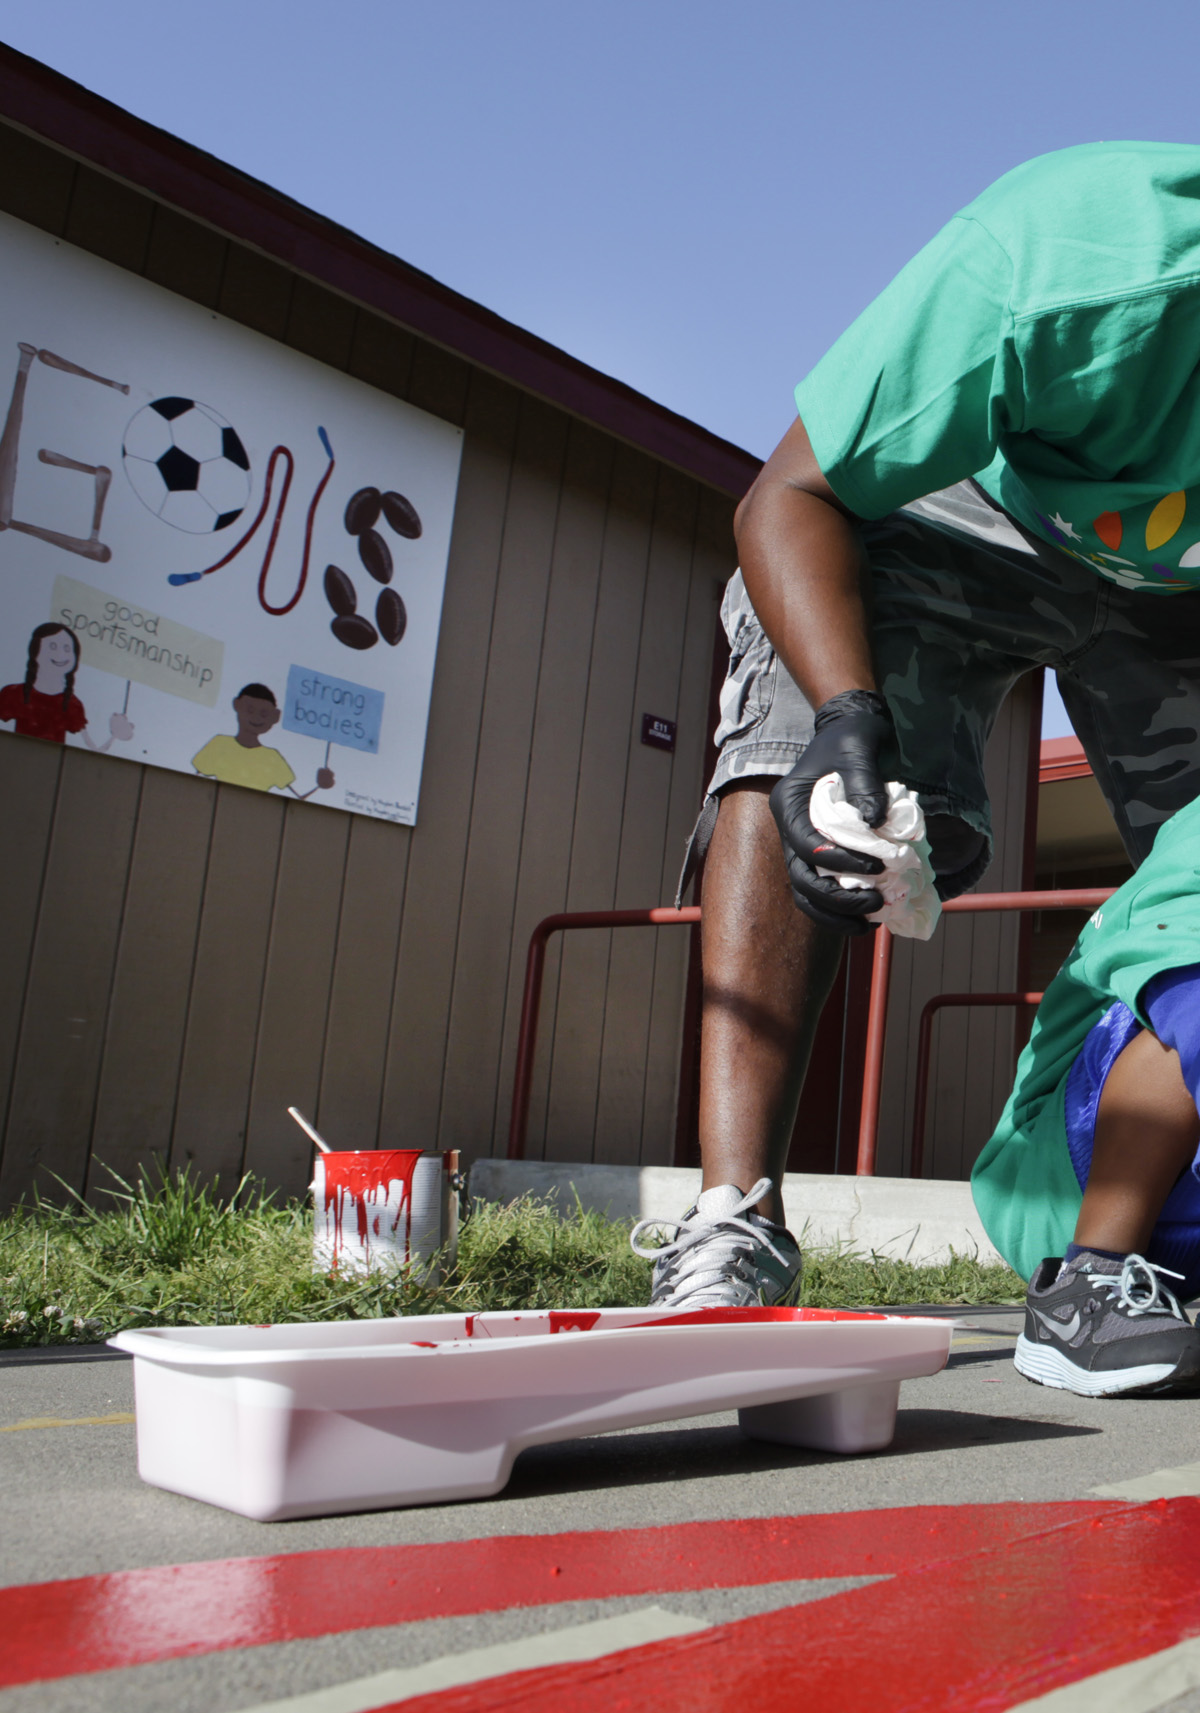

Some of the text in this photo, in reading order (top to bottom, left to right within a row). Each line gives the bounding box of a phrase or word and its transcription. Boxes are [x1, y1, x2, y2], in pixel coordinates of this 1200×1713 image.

[103, 601, 161, 636] good
[59, 608, 214, 688] sportsmanship
[300, 676, 366, 716] strong
[653, 720, 668, 733] E11
